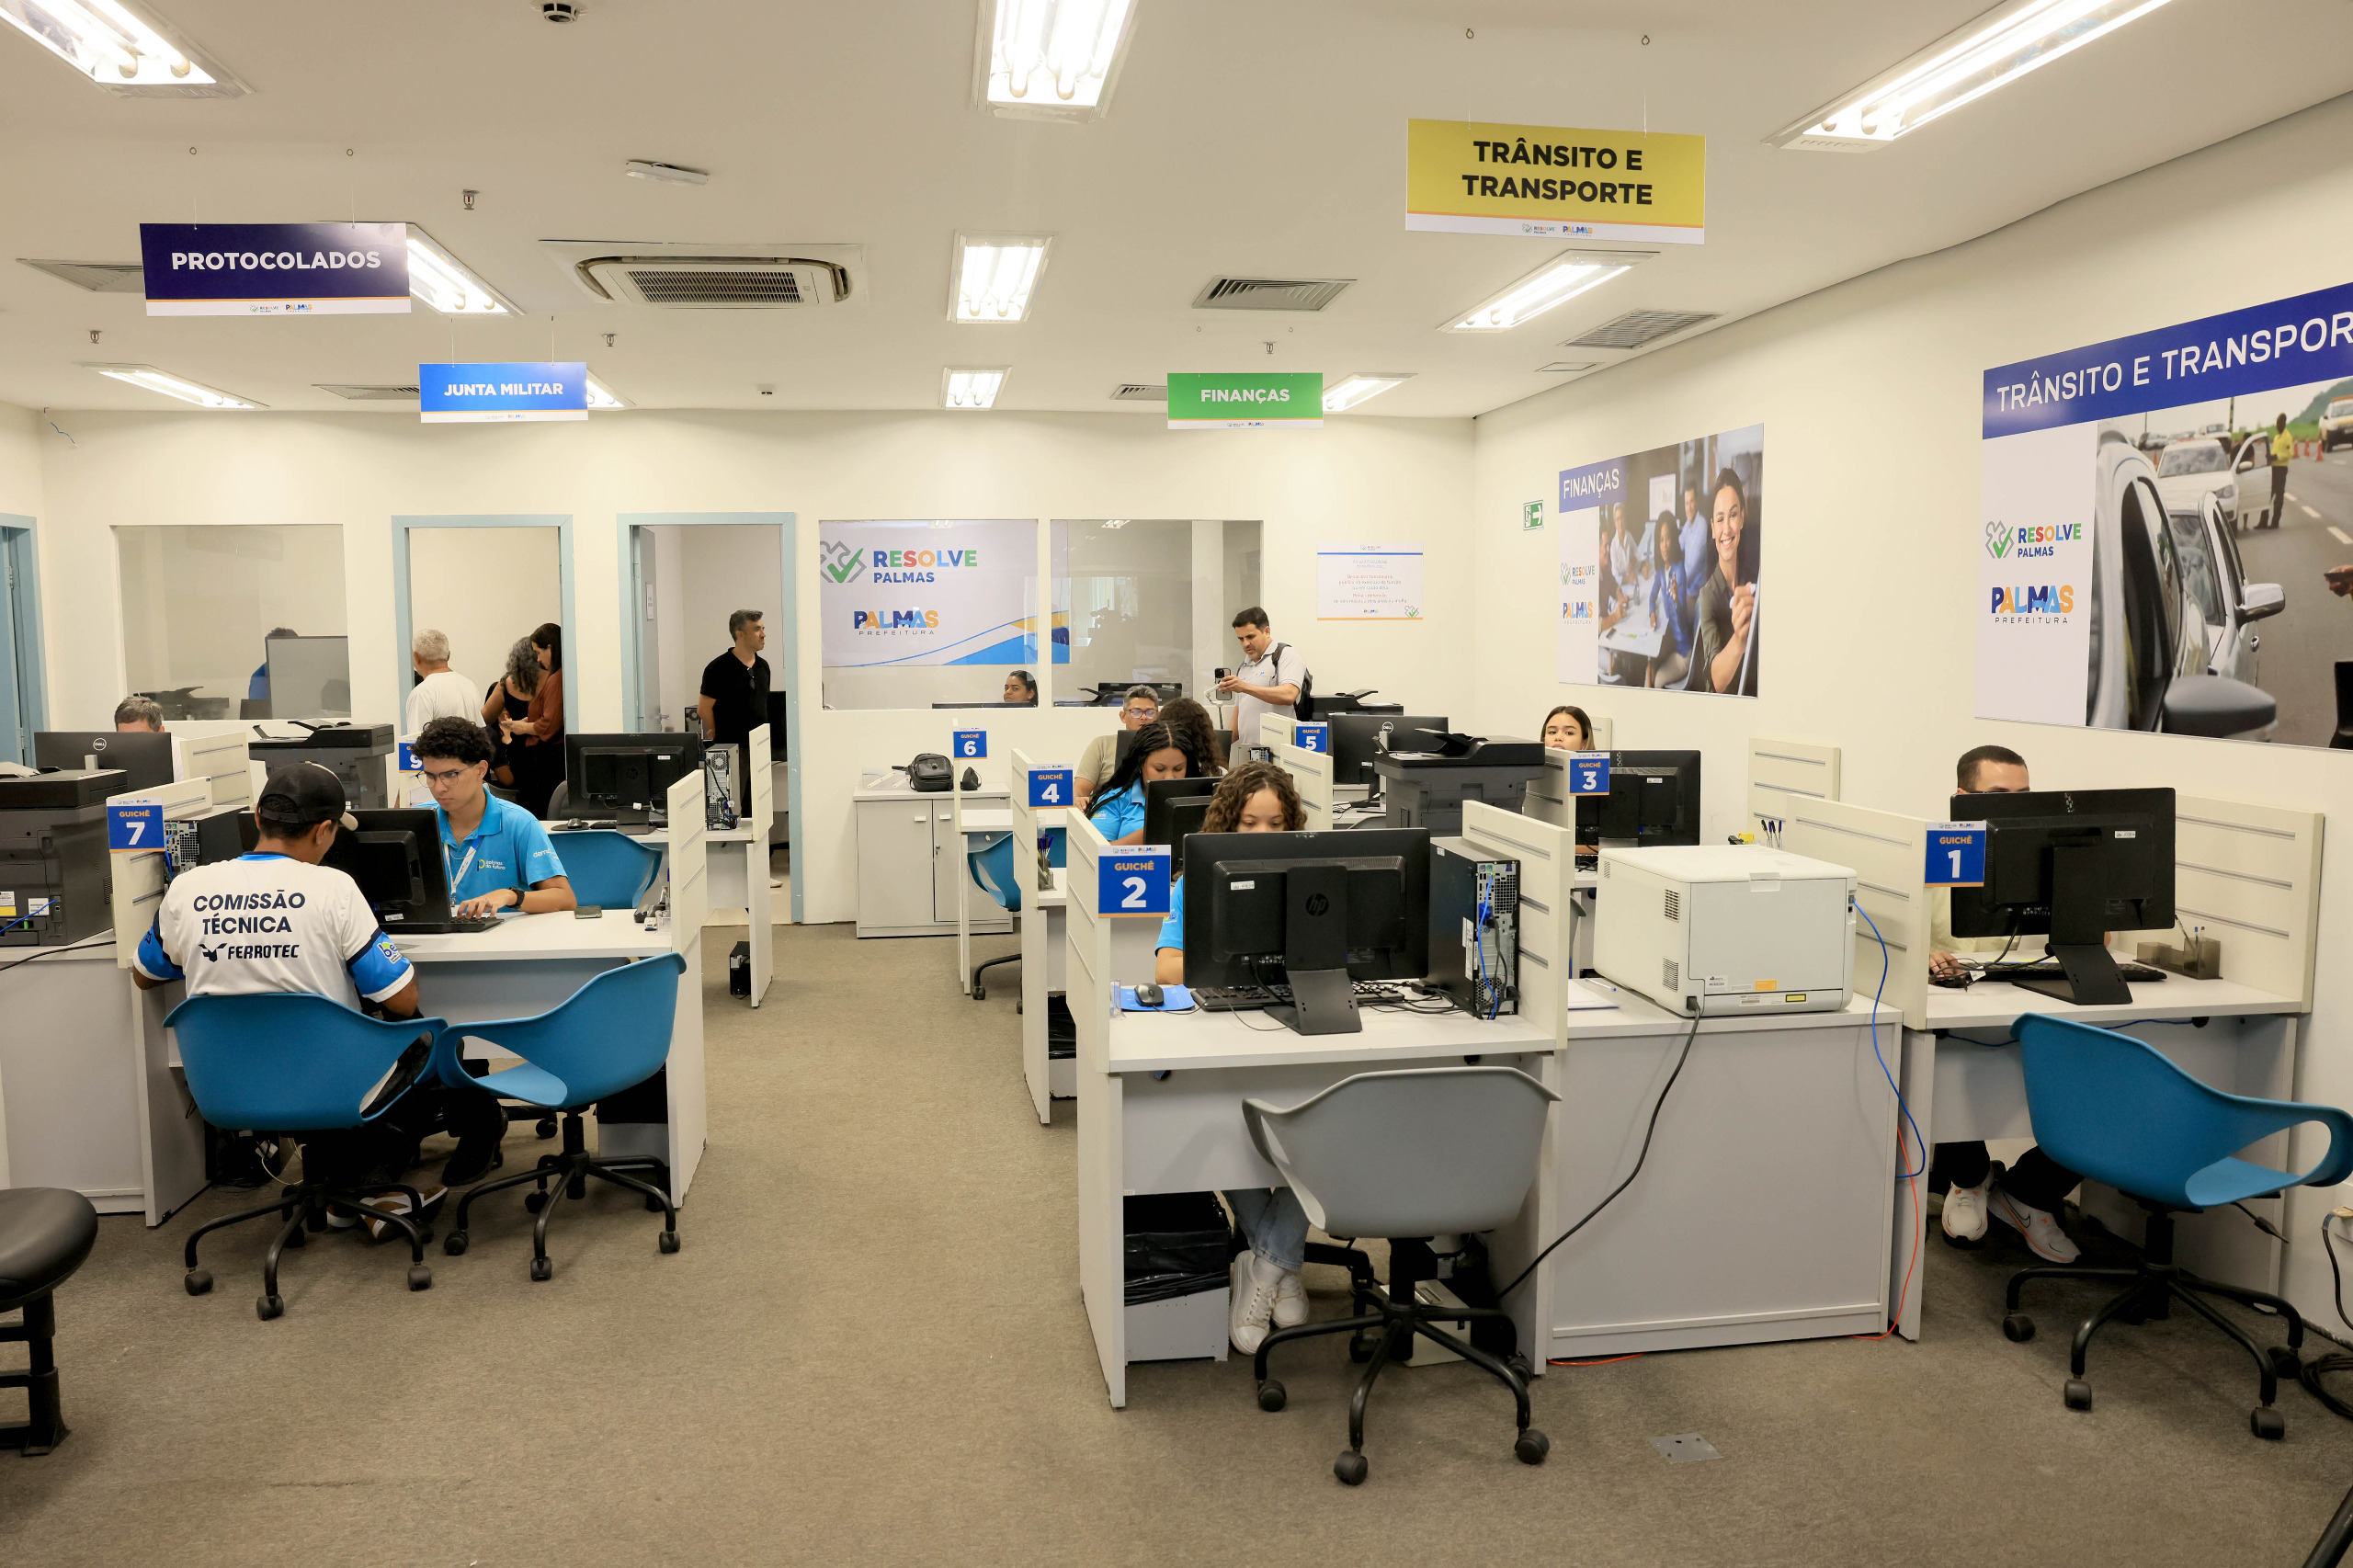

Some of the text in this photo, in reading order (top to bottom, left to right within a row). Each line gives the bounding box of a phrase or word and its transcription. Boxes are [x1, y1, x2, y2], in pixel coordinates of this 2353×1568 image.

[1472, 138, 1643, 171] TRÂNSITO E
[1462, 175, 1653, 205] TRANSPORTE
[172, 251, 381, 270] PROTOCOLADOS
[1996, 312, 2353, 412] TRÂNSITO E TRANSPOR
[444, 383, 563, 396] JUNTA MILITAR
[1200, 389, 1290, 404] FINANÇAS
[1563, 468, 1620, 499] FINANÇAS
[2018, 523, 2082, 543] RESOLVE
[873, 550, 978, 568] RESOLVE
[2018, 546, 2054, 558] PALMAS
[873, 572, 936, 584] PALMAS
[1572, 565, 1595, 576] RESOLVE
[1991, 585, 2075, 614] PALMAS
[854, 609, 939, 630] PALMAS
[1563, 601, 1594, 619] PALMAS
[963, 740, 977, 756] 6
[1305, 735, 1317, 751] 5
[409, 754, 423, 768] 9
[1582, 771, 1597, 790] 3
[1041, 783, 1060, 803] 4
[119, 809, 151, 817] GUICHÊ
[126, 822, 145, 846] 7
[1939, 835, 1972, 845] GUICHÊ
[1114, 860, 1154, 871] GUICHÊ
[1948, 849, 1961, 879] 1
[193, 890, 306, 912] COMISSÃO
[1121, 876, 1147, 908] 2
[202, 913, 292, 936] TÉCNICA
[227, 944, 300, 960] FERROTEC
